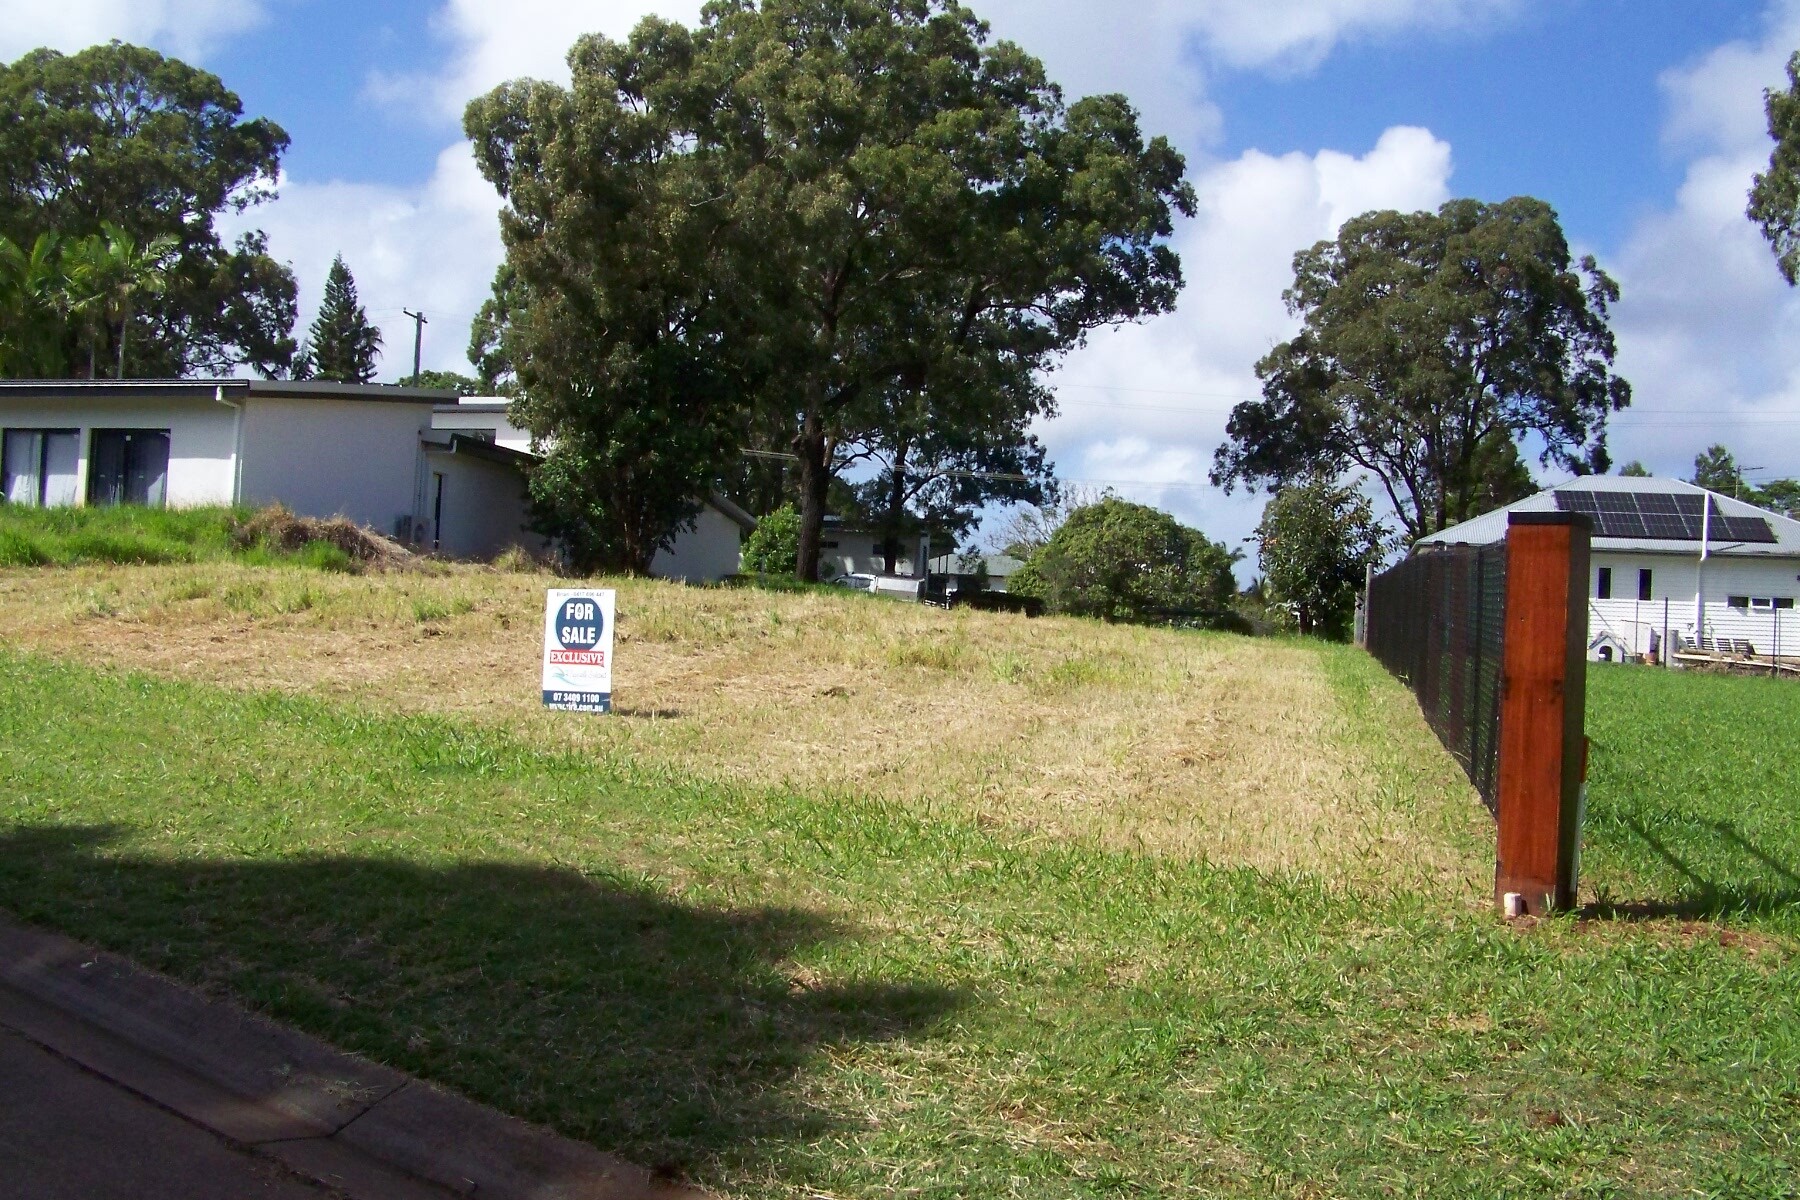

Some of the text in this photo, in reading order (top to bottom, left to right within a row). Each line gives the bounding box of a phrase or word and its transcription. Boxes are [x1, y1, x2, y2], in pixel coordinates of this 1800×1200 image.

[566, 603, 594, 620] FOR
[561, 626, 596, 644] SALE
[550, 651, 604, 664] EXCLUSIVE
[553, 692, 600, 703] 07 3409 1100
